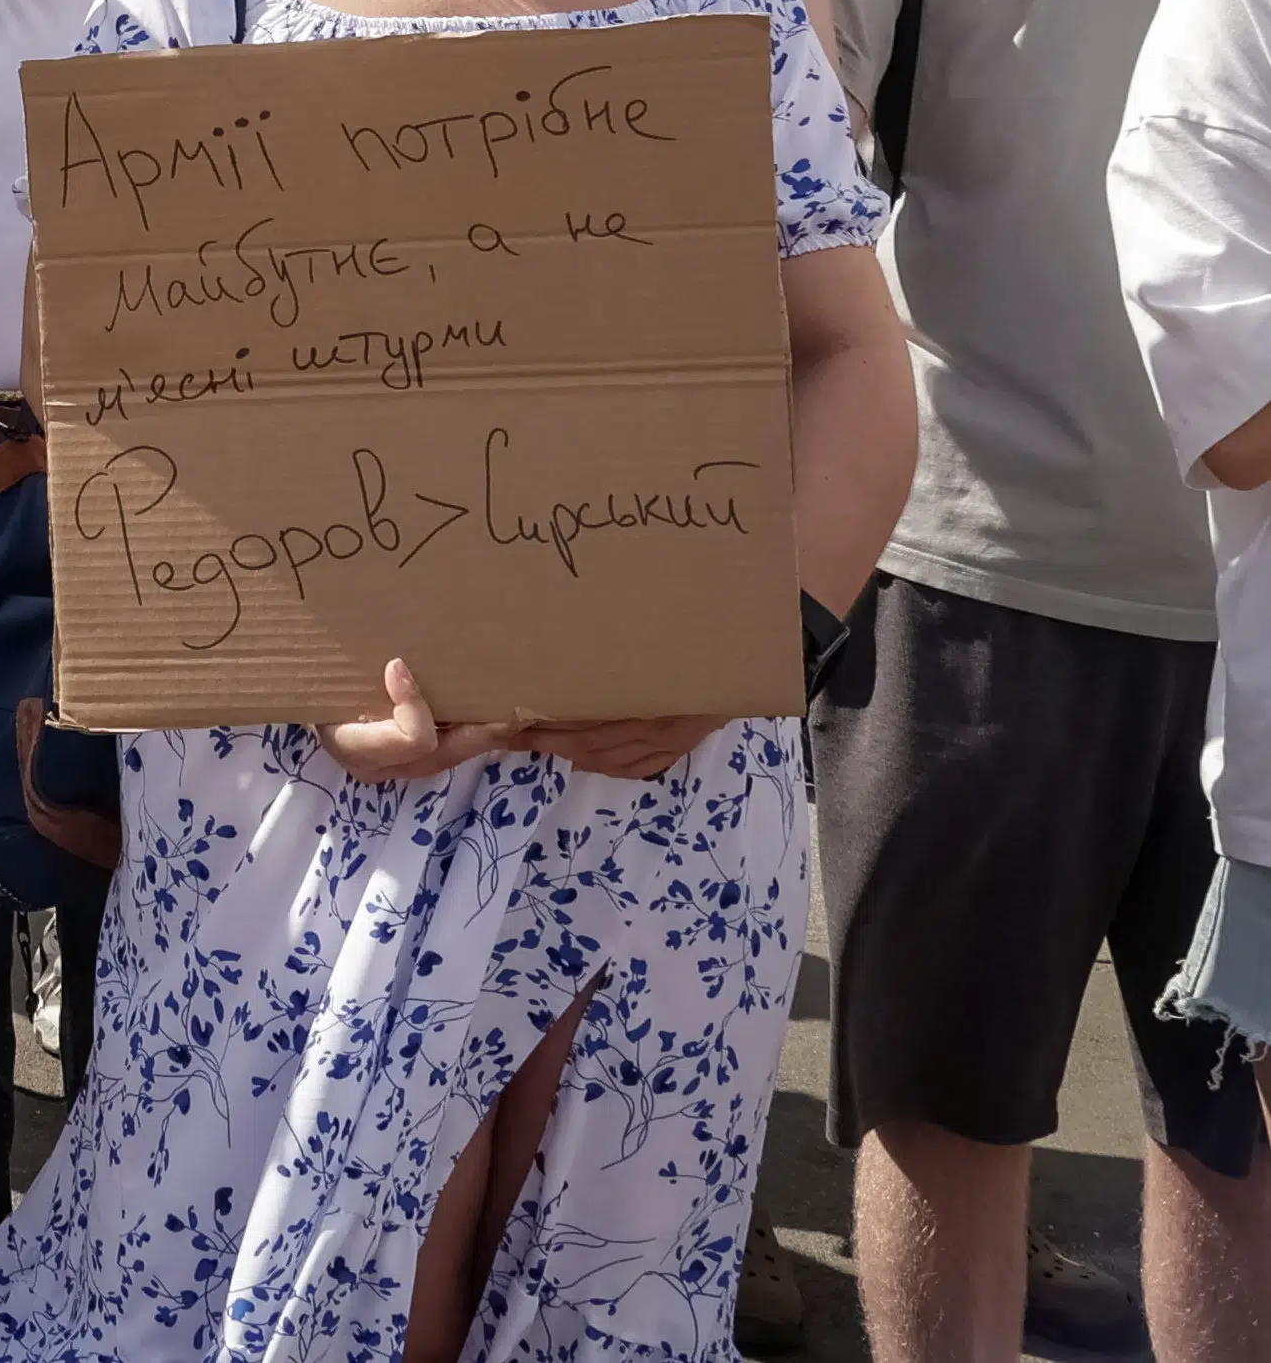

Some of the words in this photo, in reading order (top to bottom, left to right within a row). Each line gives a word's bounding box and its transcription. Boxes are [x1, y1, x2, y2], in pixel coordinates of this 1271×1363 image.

[58, 90, 285, 232] Армії
[341, 63, 678, 179] потрібне
[466, 222, 521, 257] а
[565, 210, 655, 247] не
[291, 318, 508, 390] штурми
